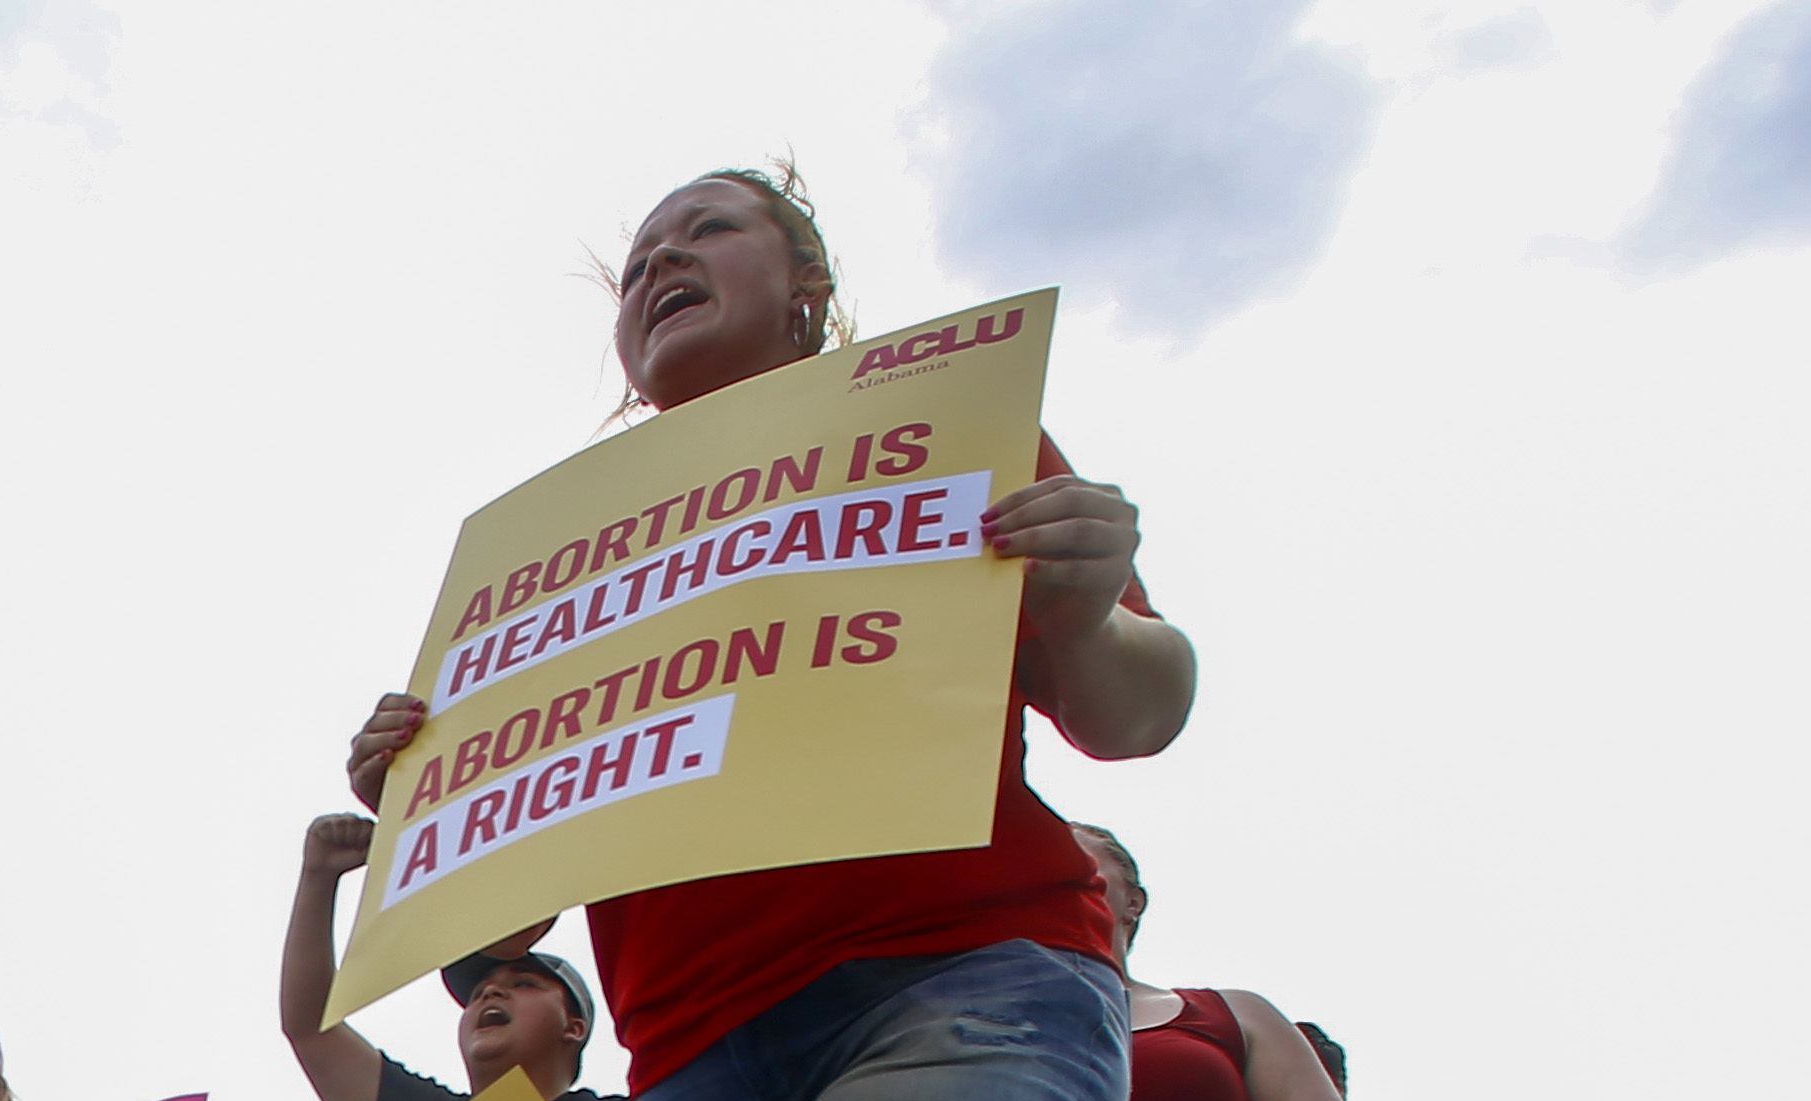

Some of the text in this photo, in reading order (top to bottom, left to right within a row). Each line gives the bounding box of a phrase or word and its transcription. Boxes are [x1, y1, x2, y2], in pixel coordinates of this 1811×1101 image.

[847, 359, 950, 394] Alabama
[851, 307, 1025, 381] ACLU
[447, 488, 971, 698] HEALTHCARE.
[451, 421, 933, 641] ABORTION IS
[396, 714, 704, 892] A RIGHT.
[403, 610, 902, 822] ABORTION IS
